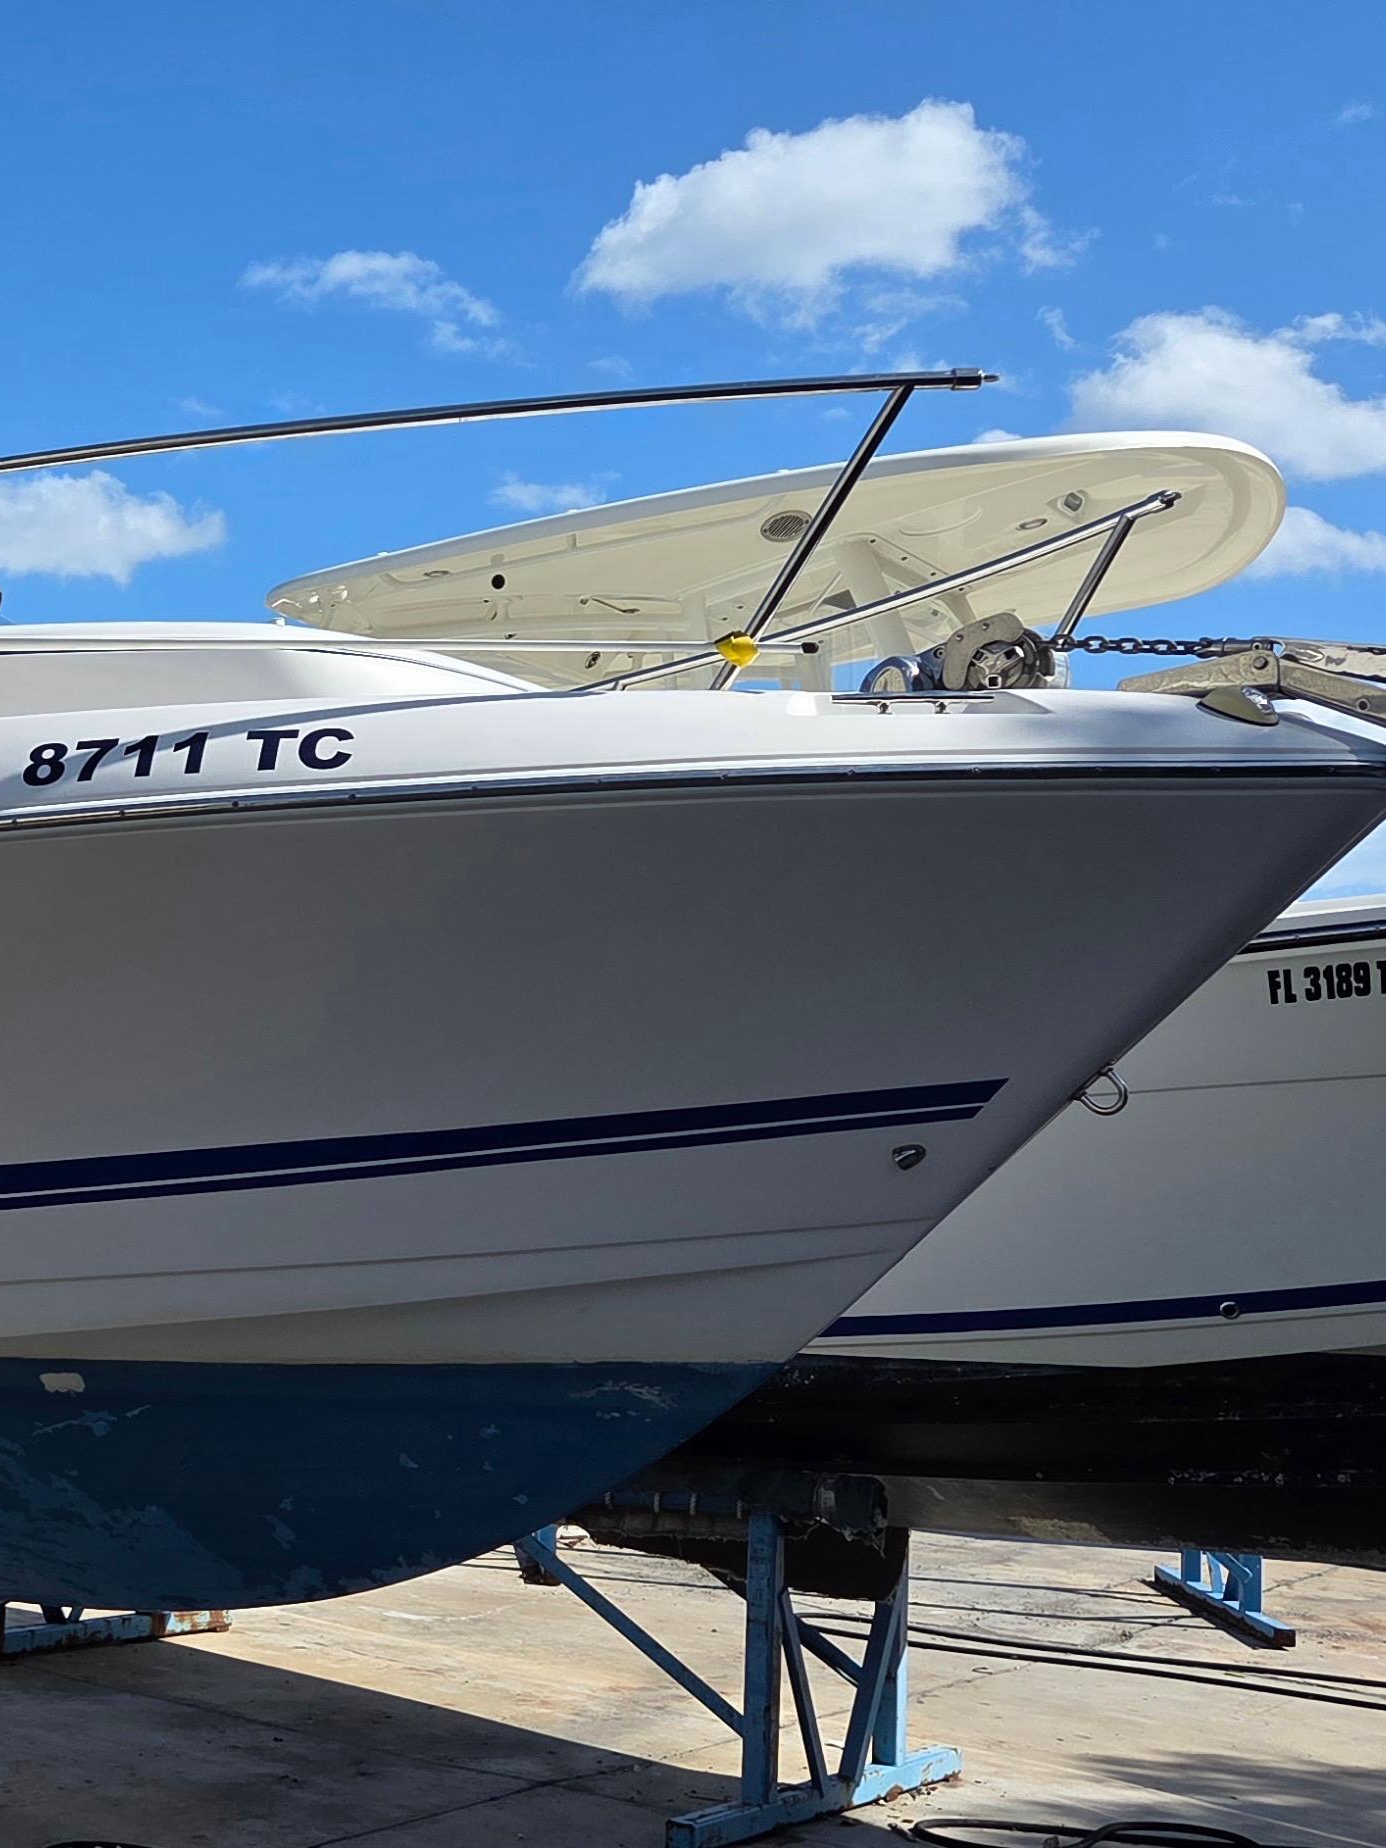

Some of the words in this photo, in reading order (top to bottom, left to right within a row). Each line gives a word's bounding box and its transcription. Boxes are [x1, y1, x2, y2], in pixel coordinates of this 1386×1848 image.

[22, 731, 210, 787] 8711
[246, 727, 355, 772] TC
[1267, 969, 1297, 1005] FL
[1303, 961, 1371, 1002] 3189
